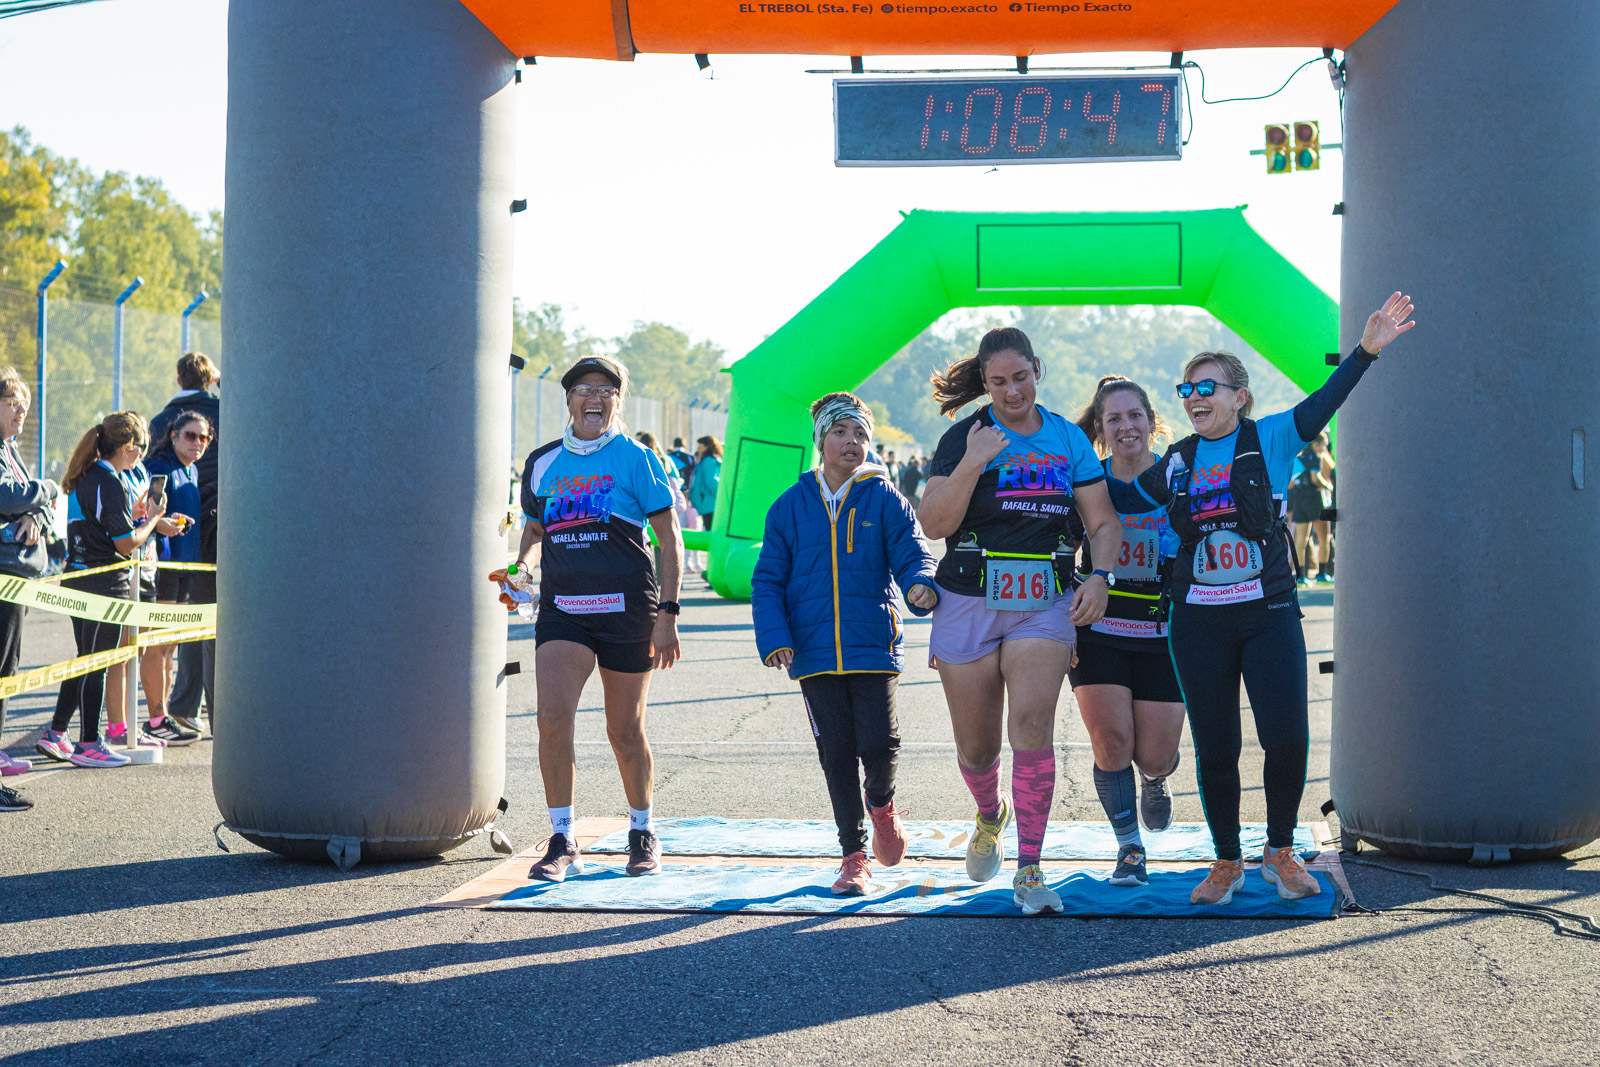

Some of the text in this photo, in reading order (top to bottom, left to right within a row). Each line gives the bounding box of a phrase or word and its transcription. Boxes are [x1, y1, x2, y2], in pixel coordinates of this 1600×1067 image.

[739, 2, 1132, 15] EL TREBOL (Sta. Fe) tiempo.exacto Tiempo Exacto
[997, 465, 1065, 490] RUN
[543, 495, 602, 524] RUN
[1002, 501, 1071, 516] RAFAELA, SANTA FE
[578, 532, 600, 542] SANTA
[600, 531, 609, 541] FE
[1147, 538, 1155, 570] EXACTO
[992, 569, 1000, 601] TIEMPO
[1000, 572, 1044, 600] 216
[1234, 581, 1258, 594] Salud
[35, 591, 88, 612] PRECAUCION
[556, 595, 621, 606] Prevención Salud
[148, 612, 203, 623] PRECAUCION
[1099, 617, 1143, 629] revención
